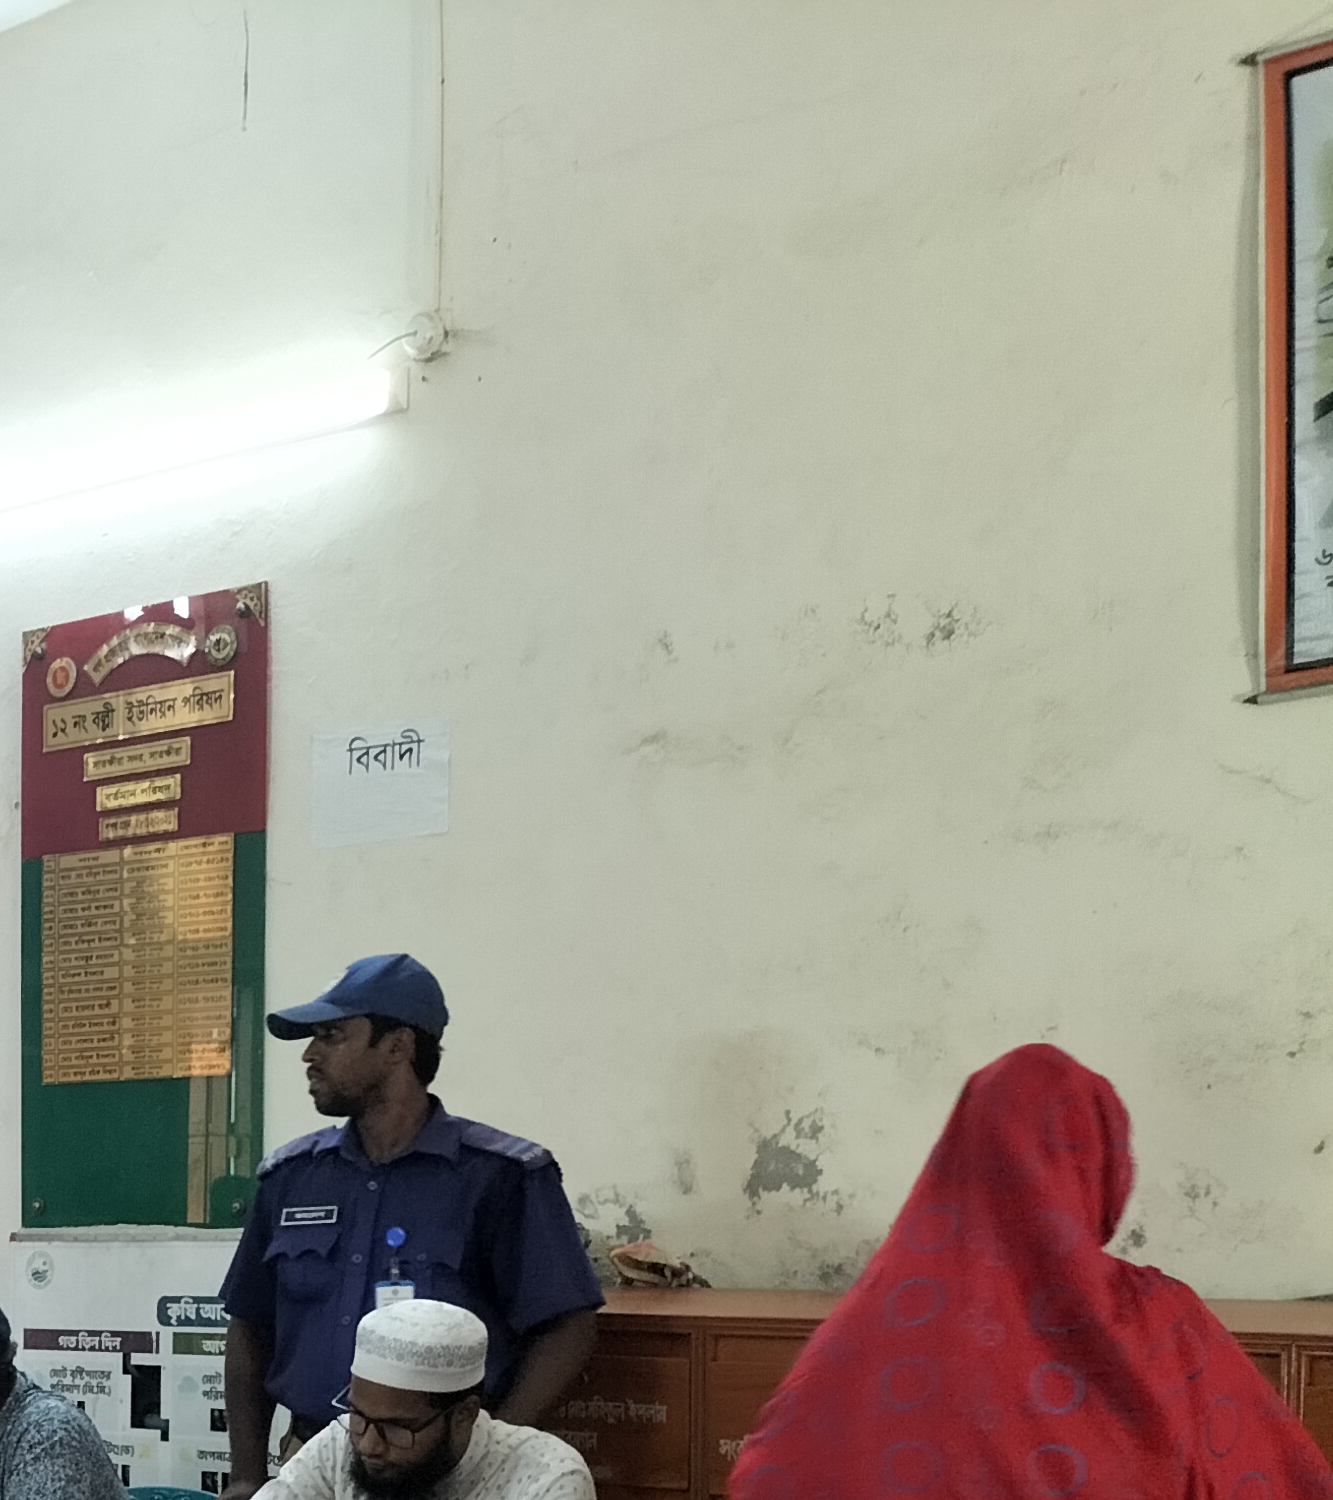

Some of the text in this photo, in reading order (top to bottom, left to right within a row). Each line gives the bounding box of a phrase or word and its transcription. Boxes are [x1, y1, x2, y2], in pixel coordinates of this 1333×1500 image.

[52, 718, 69, 739] ১২
[72, 713, 87, 733] নং
[125, 694, 177, 725] ইউনিয়ন
[182, 685, 224, 715] পরিষদ
[346, 728, 426, 775] বিবাদী
[167, 1297, 198, 1325] কৃষি
[58, 1331, 122, 1350] গত তিন দিন
